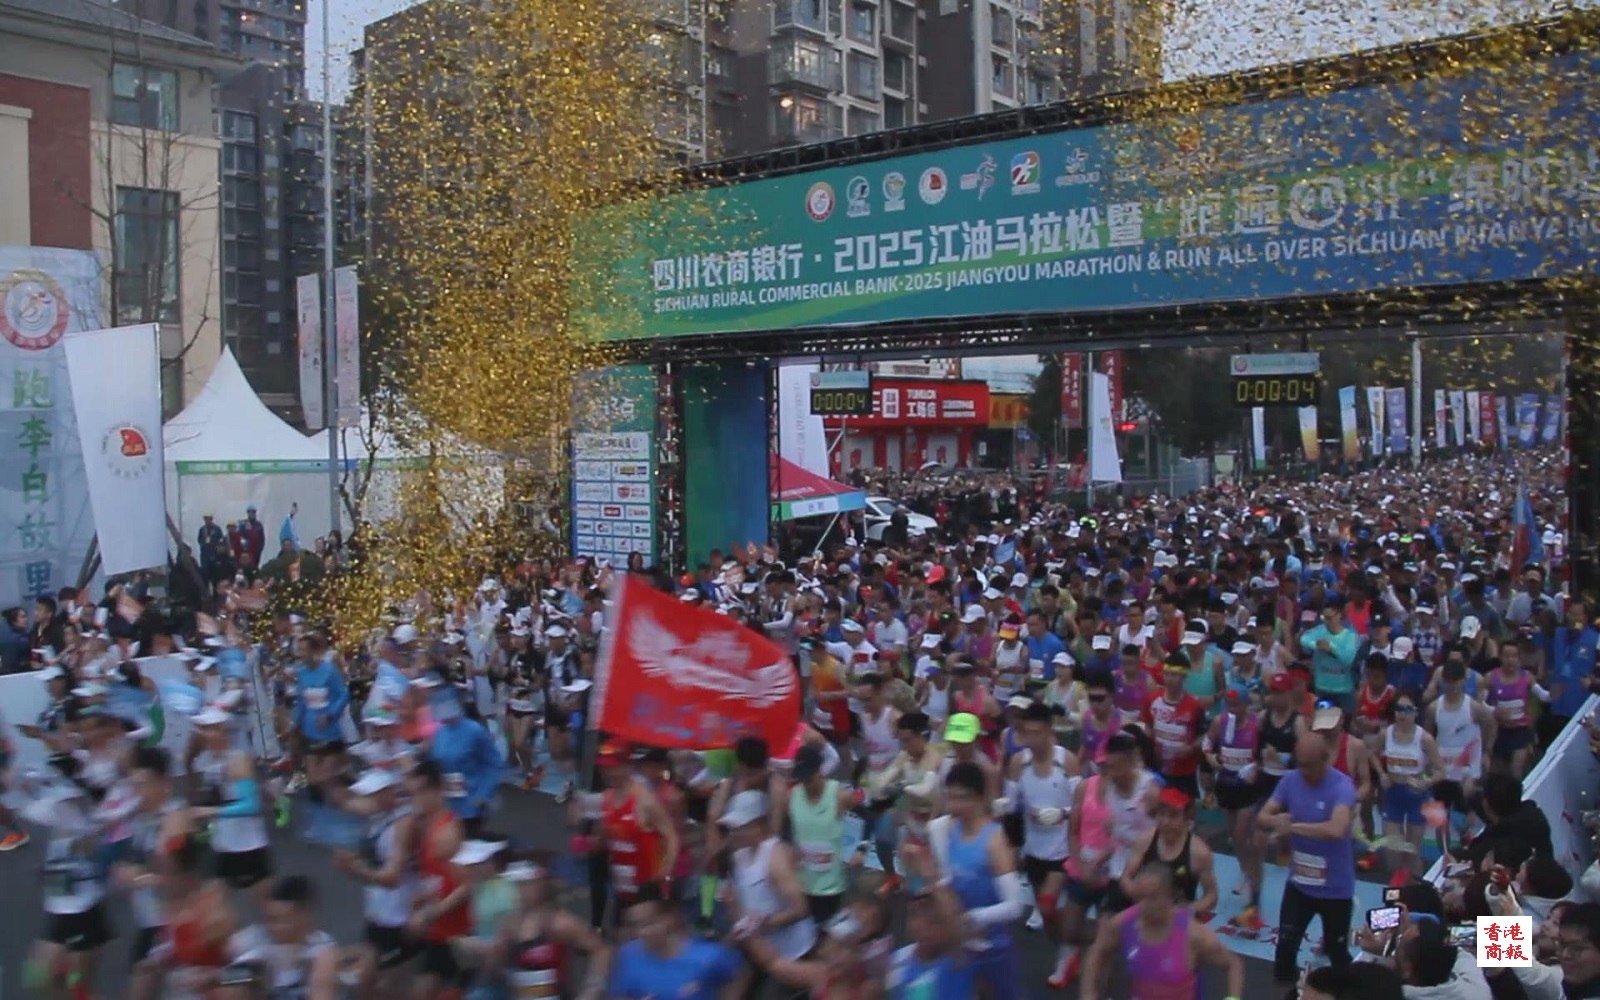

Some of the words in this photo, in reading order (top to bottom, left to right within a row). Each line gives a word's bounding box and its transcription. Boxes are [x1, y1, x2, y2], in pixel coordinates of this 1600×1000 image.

[654, 294, 710, 313] SICHUAN
[712, 288, 756, 308] RURAL
[759, 281, 852, 304] COMMERCIAL
[945, 264, 1030, 291] JIANGYOU
[1035, 255, 1142, 281] MARATHON
[1165, 246, 1211, 270] RUN
[1217, 242, 1258, 267] ALL
[1265, 237, 1327, 263] OVER
[1332, 228, 1447, 258] SICHUAN
[813, 392, 866, 411] 0:00:04
[1236, 379, 1315, 403] 0:00:04
[12, 369, 56, 600] 跑李白故里
